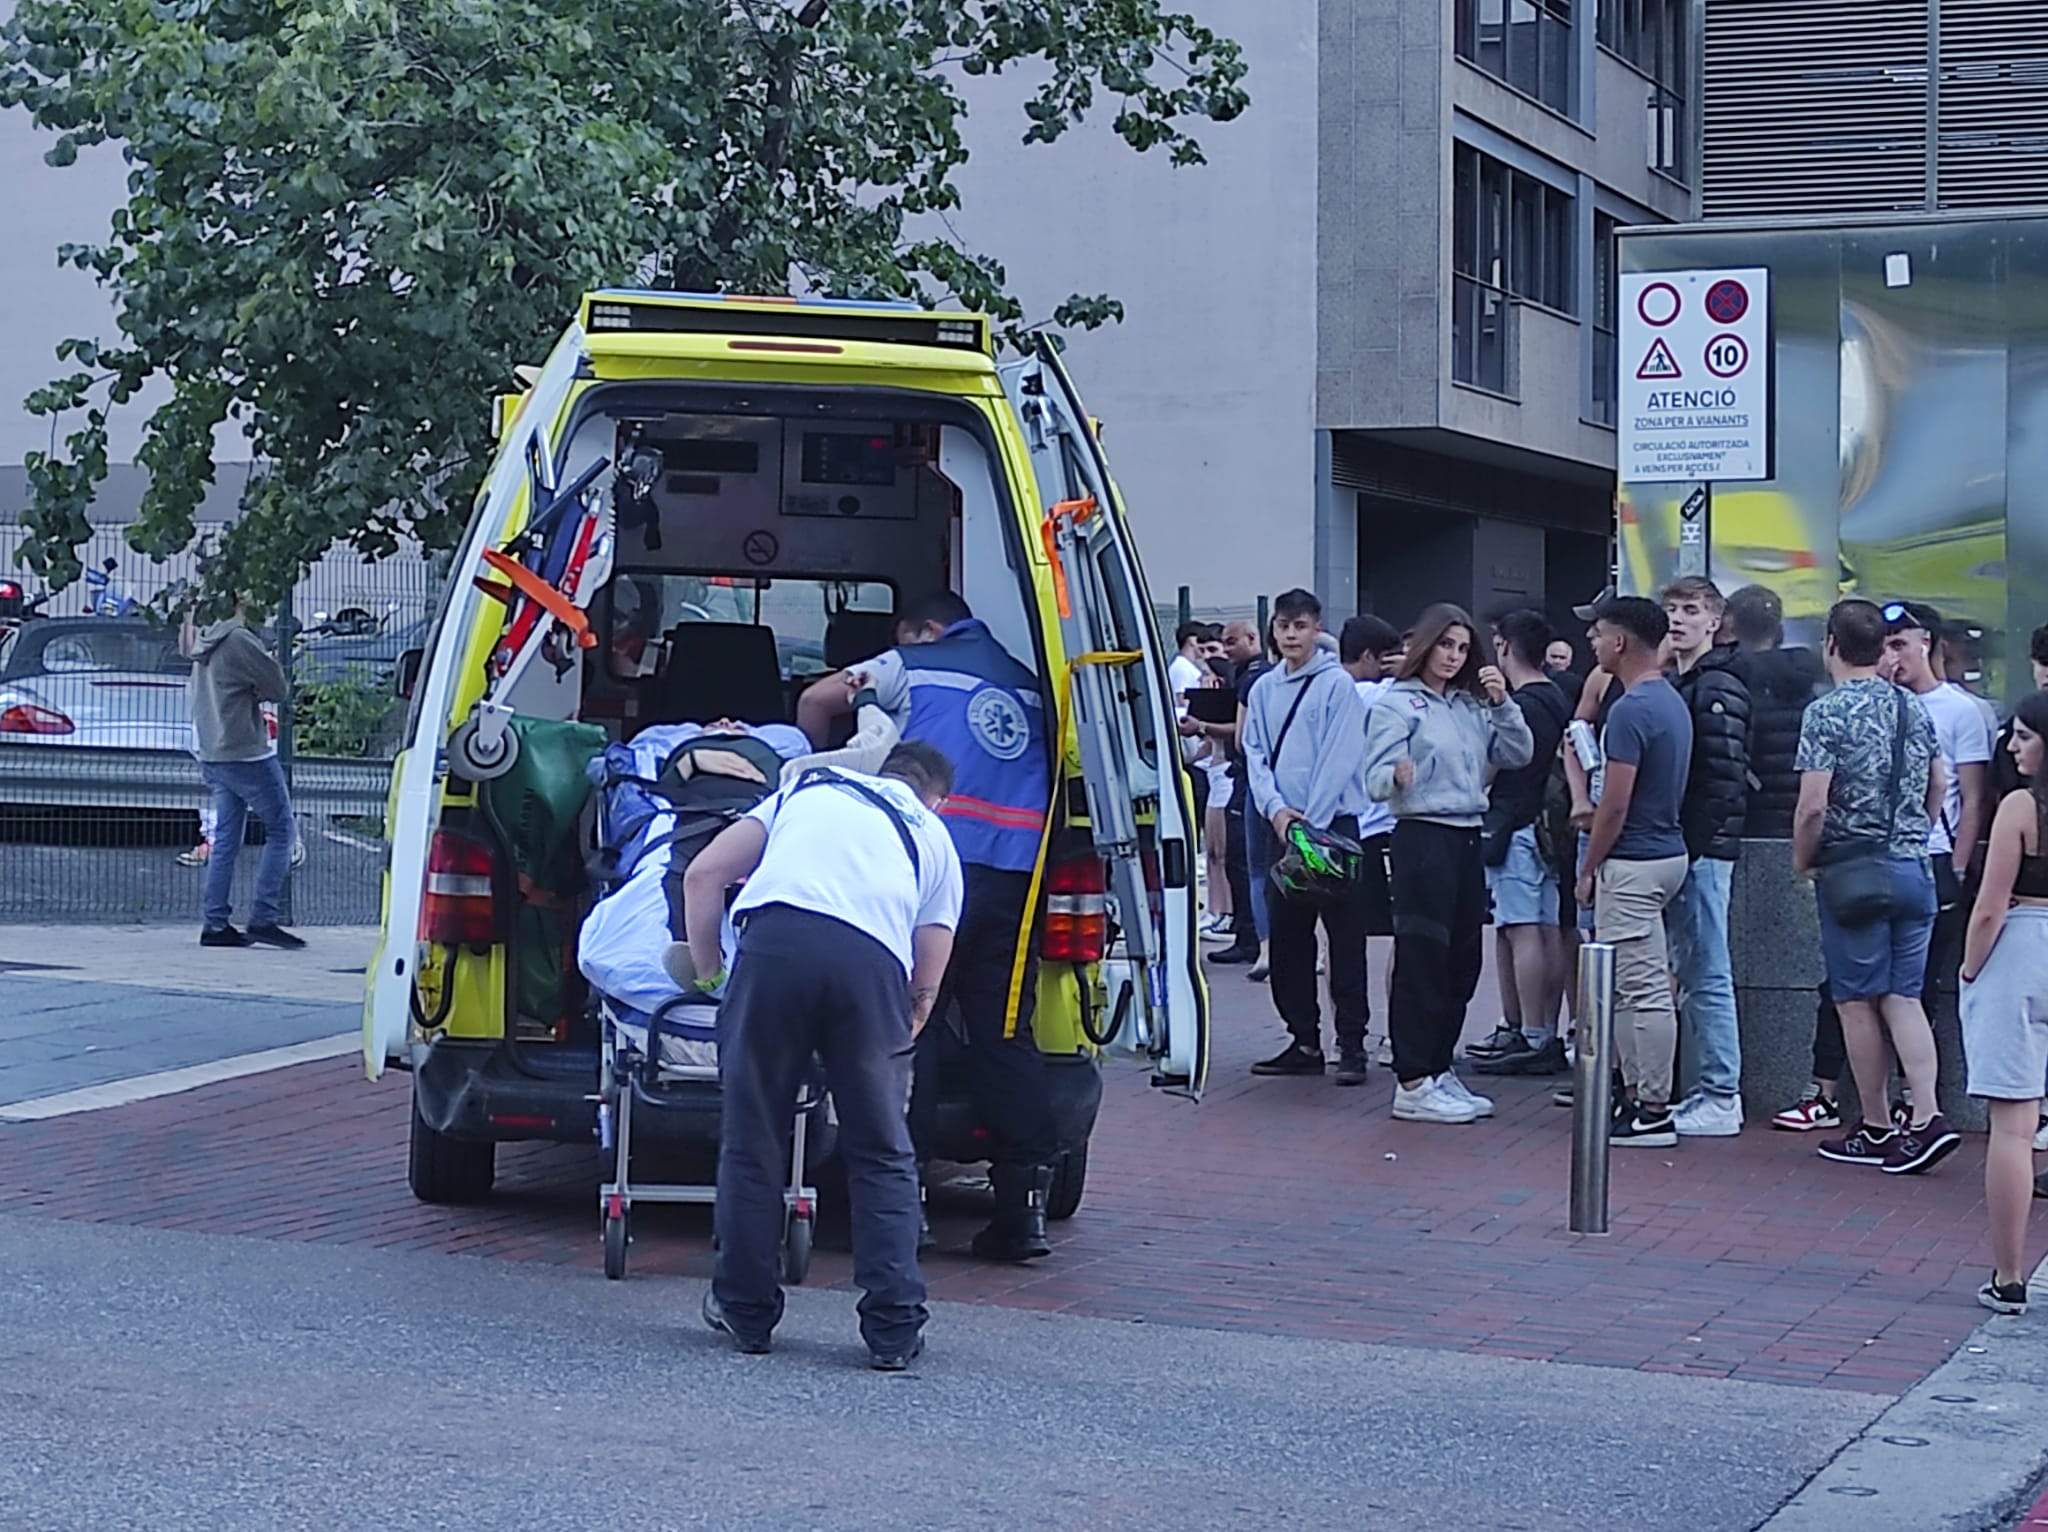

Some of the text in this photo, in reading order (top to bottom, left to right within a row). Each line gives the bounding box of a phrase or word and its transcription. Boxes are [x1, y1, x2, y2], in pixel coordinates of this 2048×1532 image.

[1712, 345, 1738, 367] 10
[1647, 386, 1736, 409] ATENCIÓ
[1634, 414, 1749, 429] ZONA PER A VIANANTS
[1688, 439, 1749, 450] AUTORITZADA
